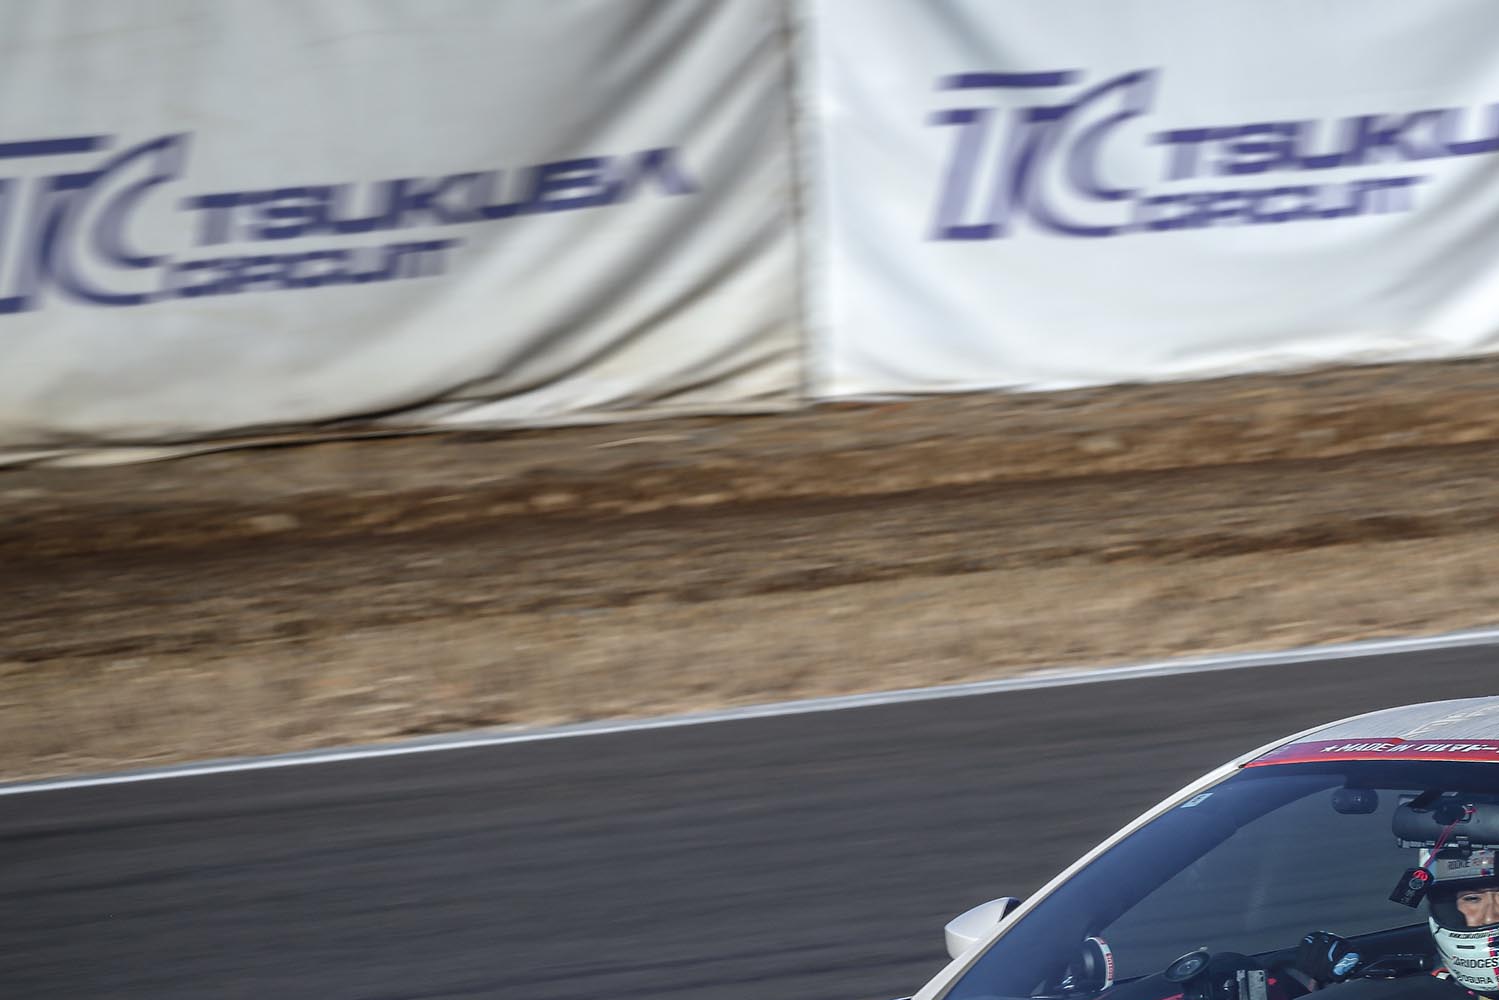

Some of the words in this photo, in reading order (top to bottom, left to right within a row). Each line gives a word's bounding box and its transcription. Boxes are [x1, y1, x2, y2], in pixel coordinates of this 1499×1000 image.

[177, 145, 702, 247] TSUKUBA
[1136, 174, 1434, 233] CIRCUIT
[160, 237, 468, 299] CIRCUIT
[1335, 742, 1395, 753] MADE
